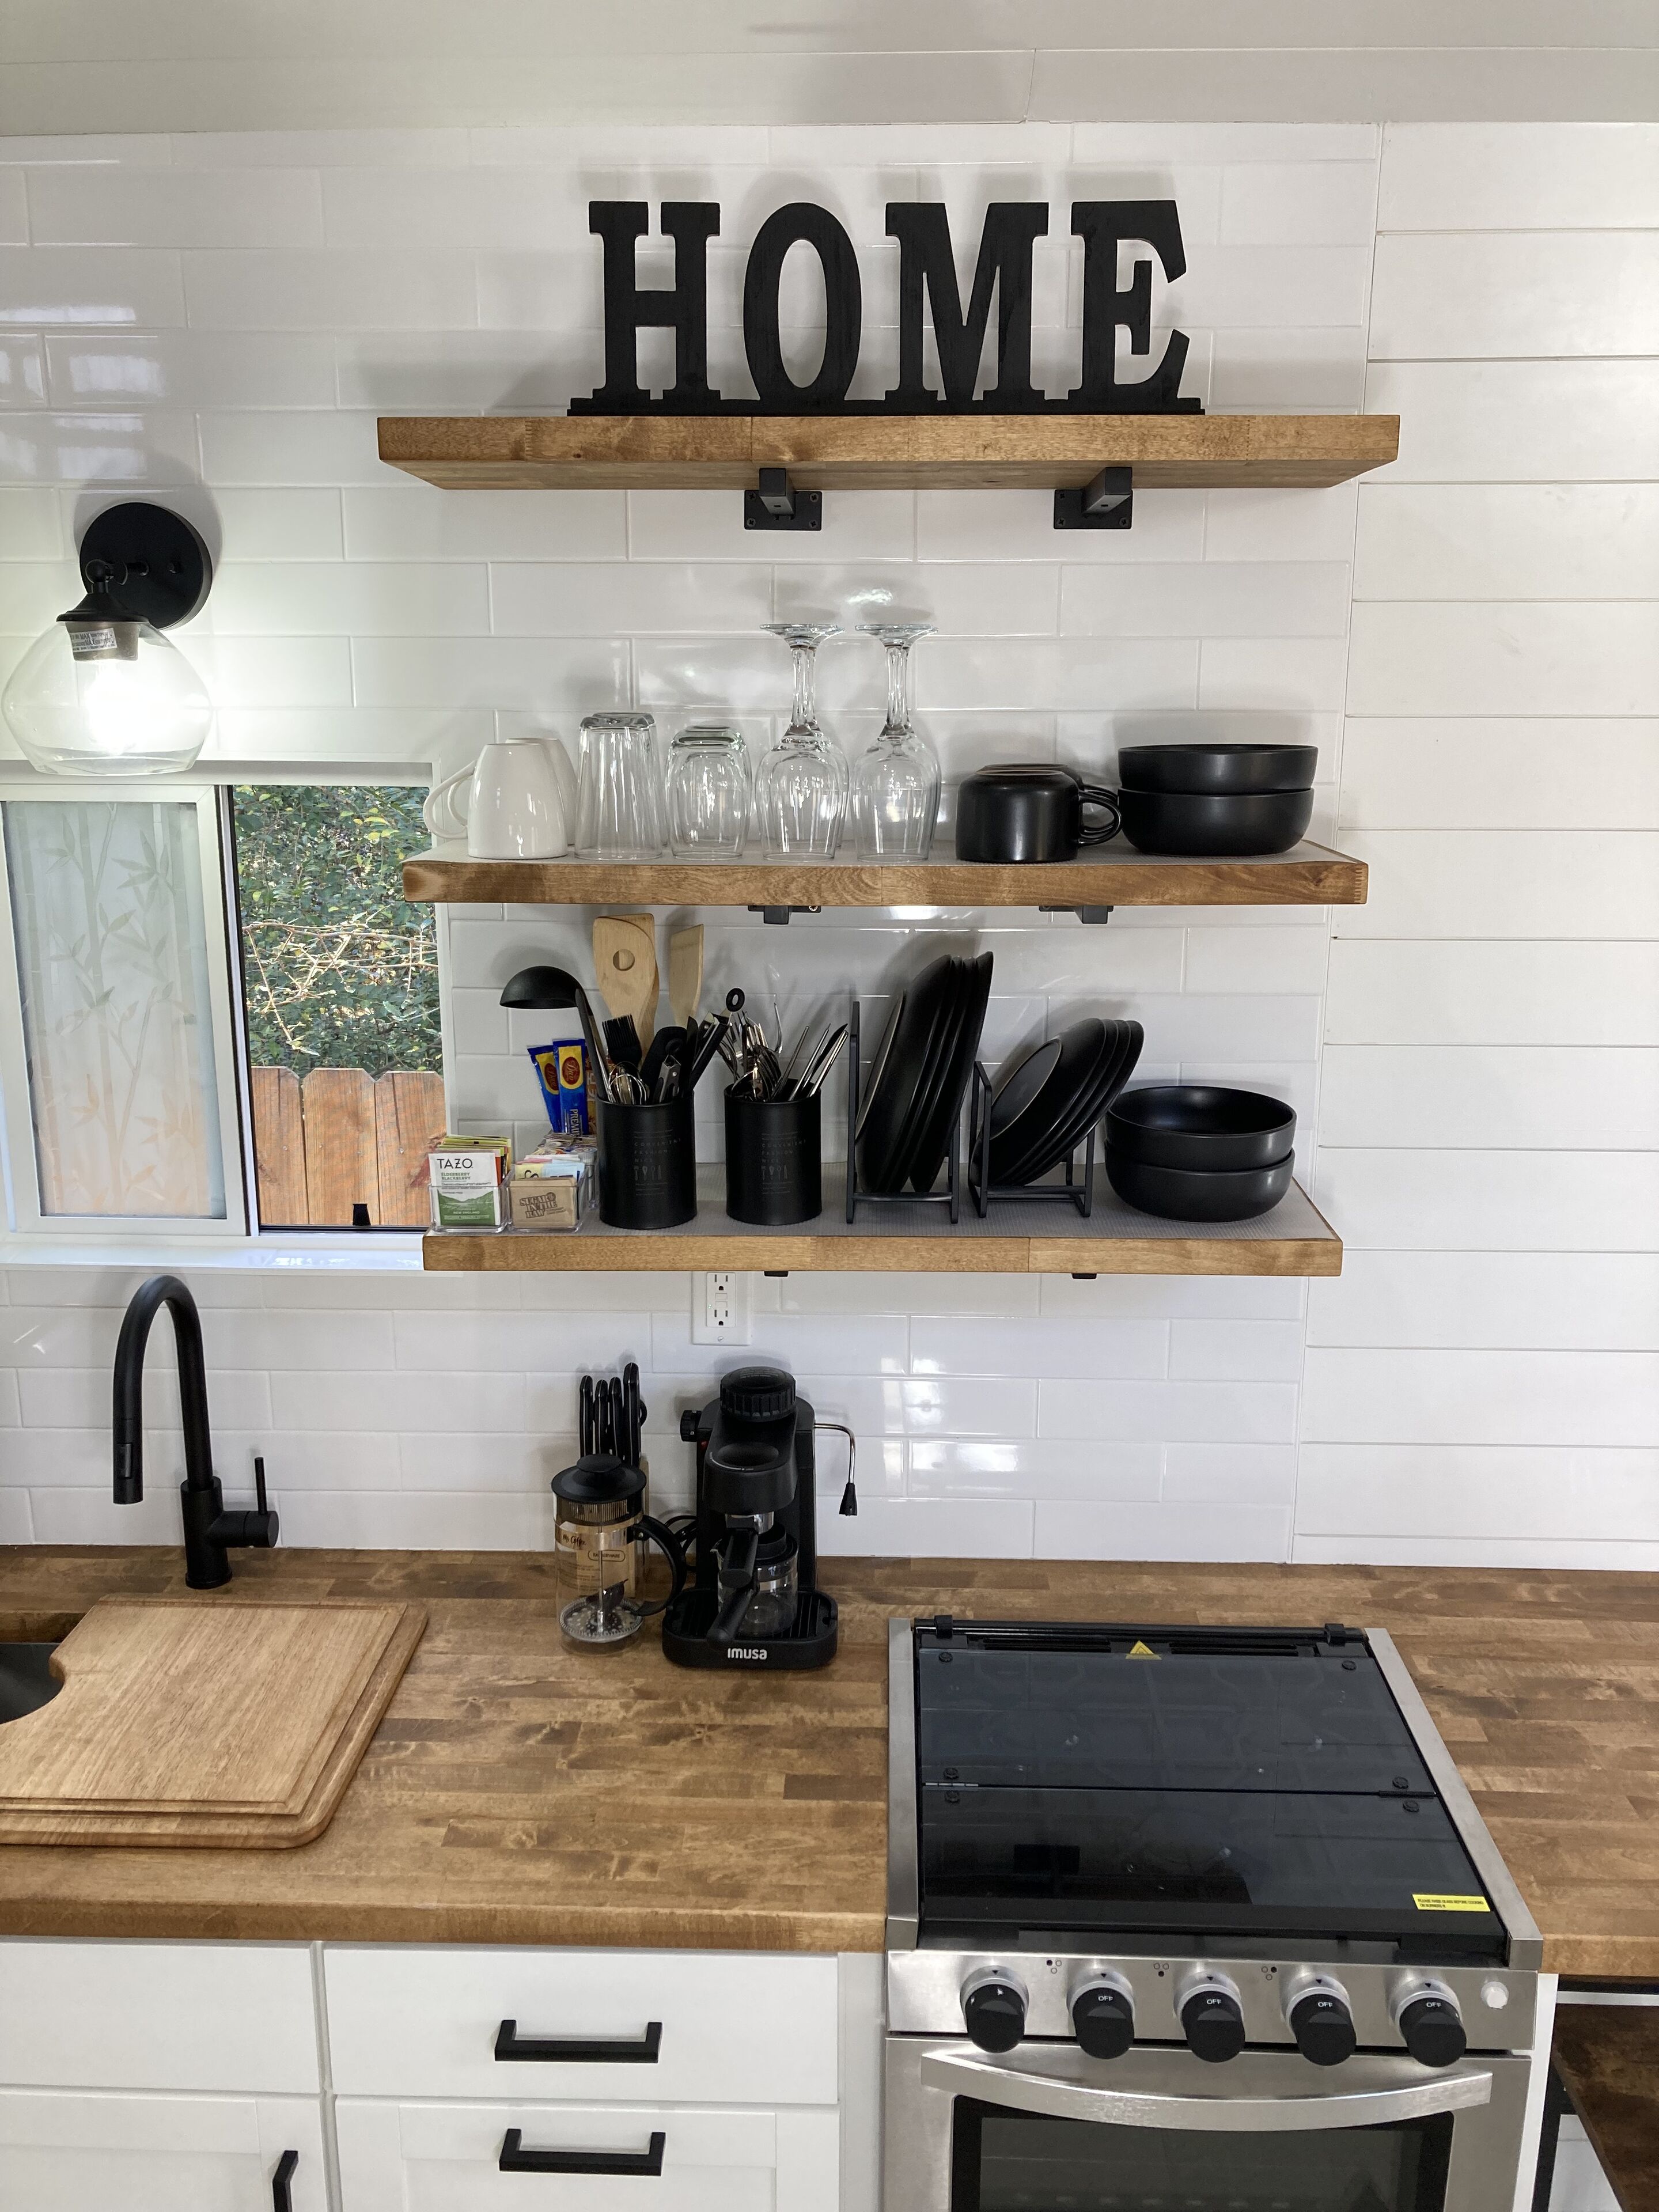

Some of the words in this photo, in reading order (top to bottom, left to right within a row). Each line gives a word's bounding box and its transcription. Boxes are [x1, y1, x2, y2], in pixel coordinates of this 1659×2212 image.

[589, 200, 1190, 403] HOME
[570, 1109, 580, 1136] PREMI
[437, 1158, 472, 1169] TAZO
[520, 1195, 550, 1206] SUGAR
[525, 1209, 546, 1218] RAW
